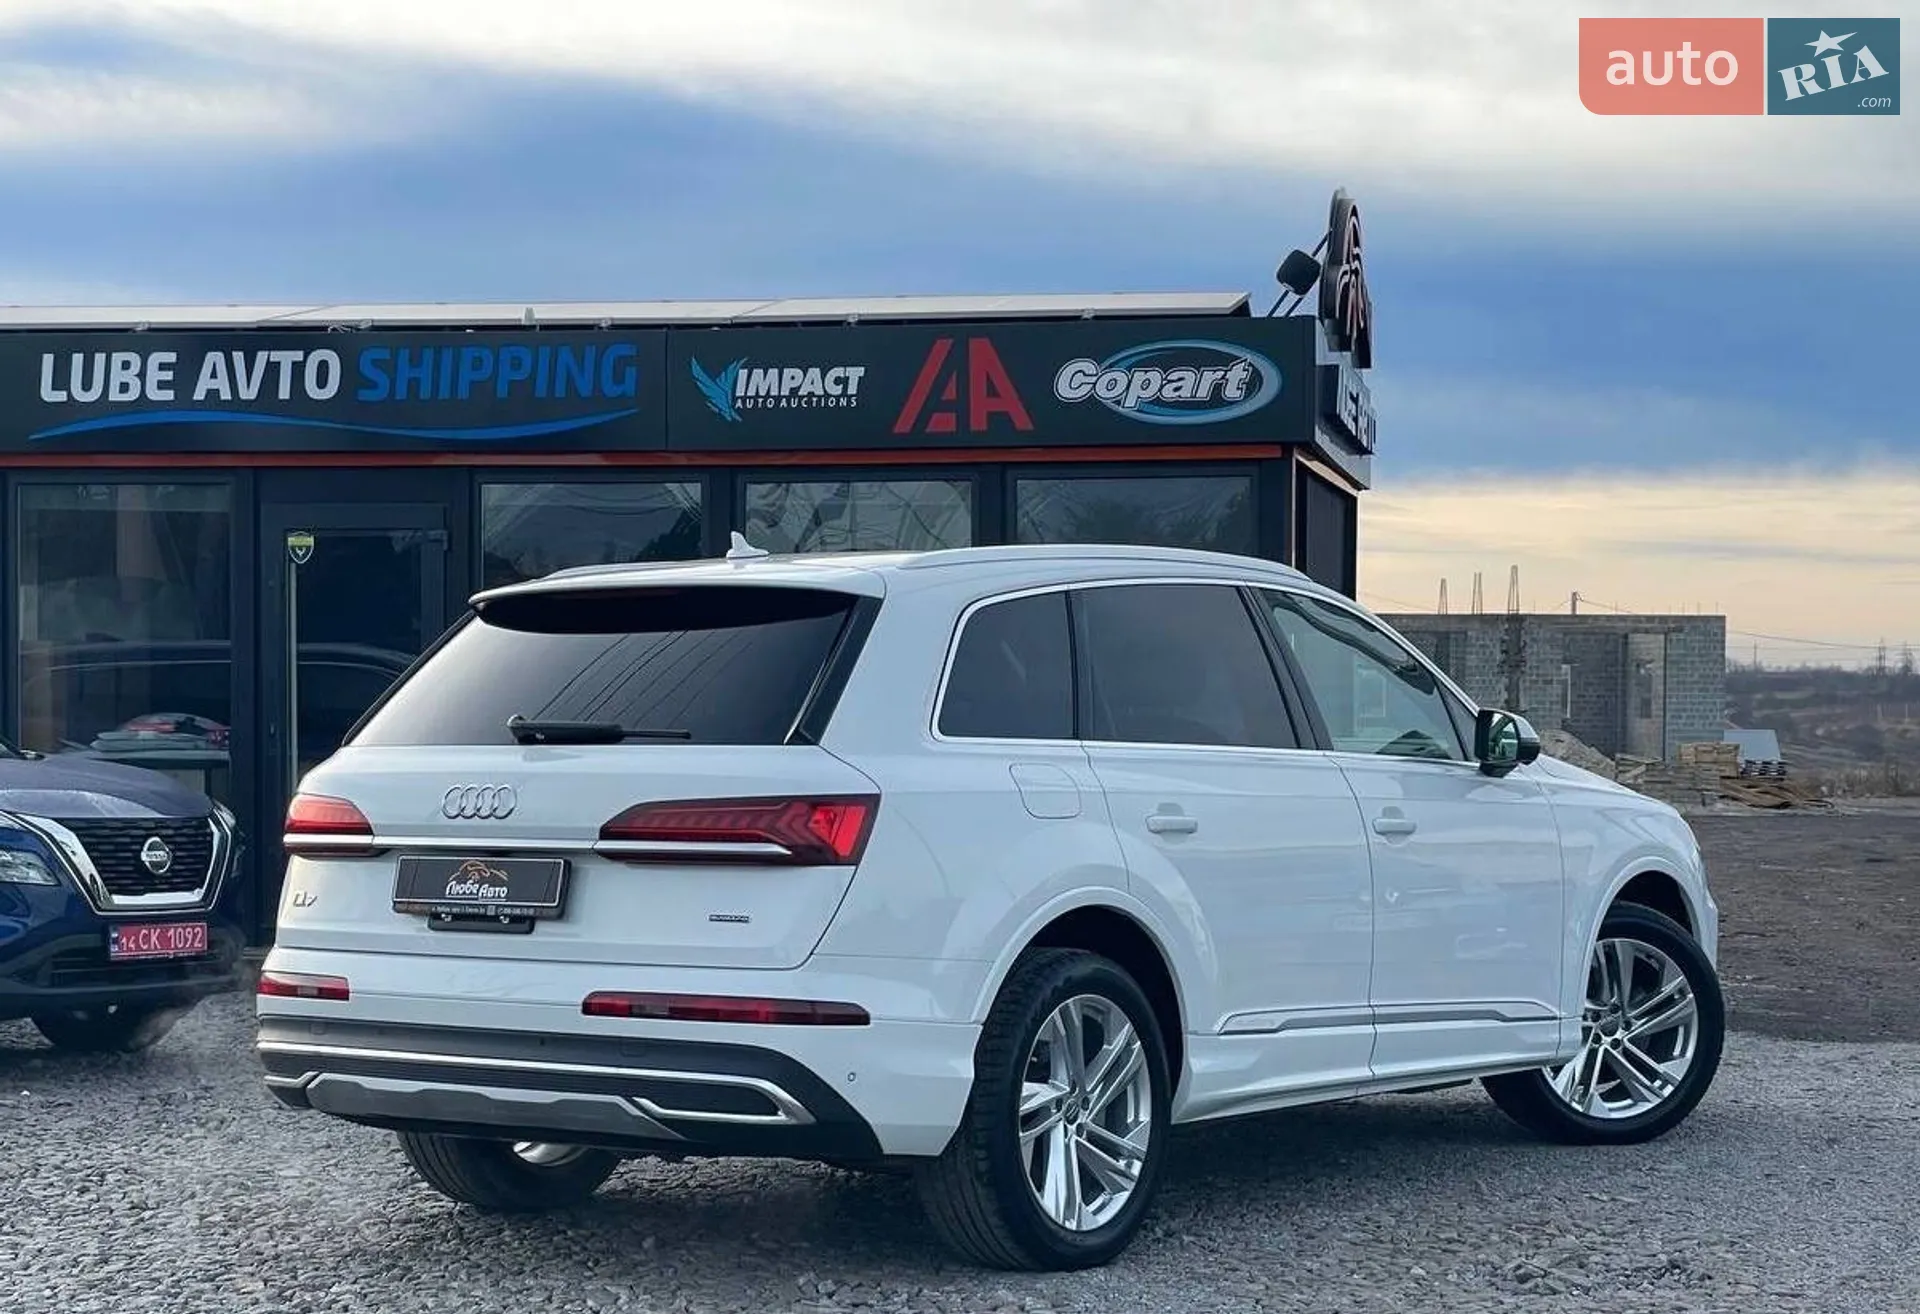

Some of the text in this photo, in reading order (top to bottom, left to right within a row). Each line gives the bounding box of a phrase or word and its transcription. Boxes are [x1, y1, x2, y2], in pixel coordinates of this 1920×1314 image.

[40, 343, 639, 403] LUBE AVTO SHIPPING
[735, 366, 866, 397] IMPACT
[1054, 356, 1251, 410] Copart
[735, 396, 858, 409] AUTO AUCTIONS
[120, 927, 203, 951] 14 CK 1092
